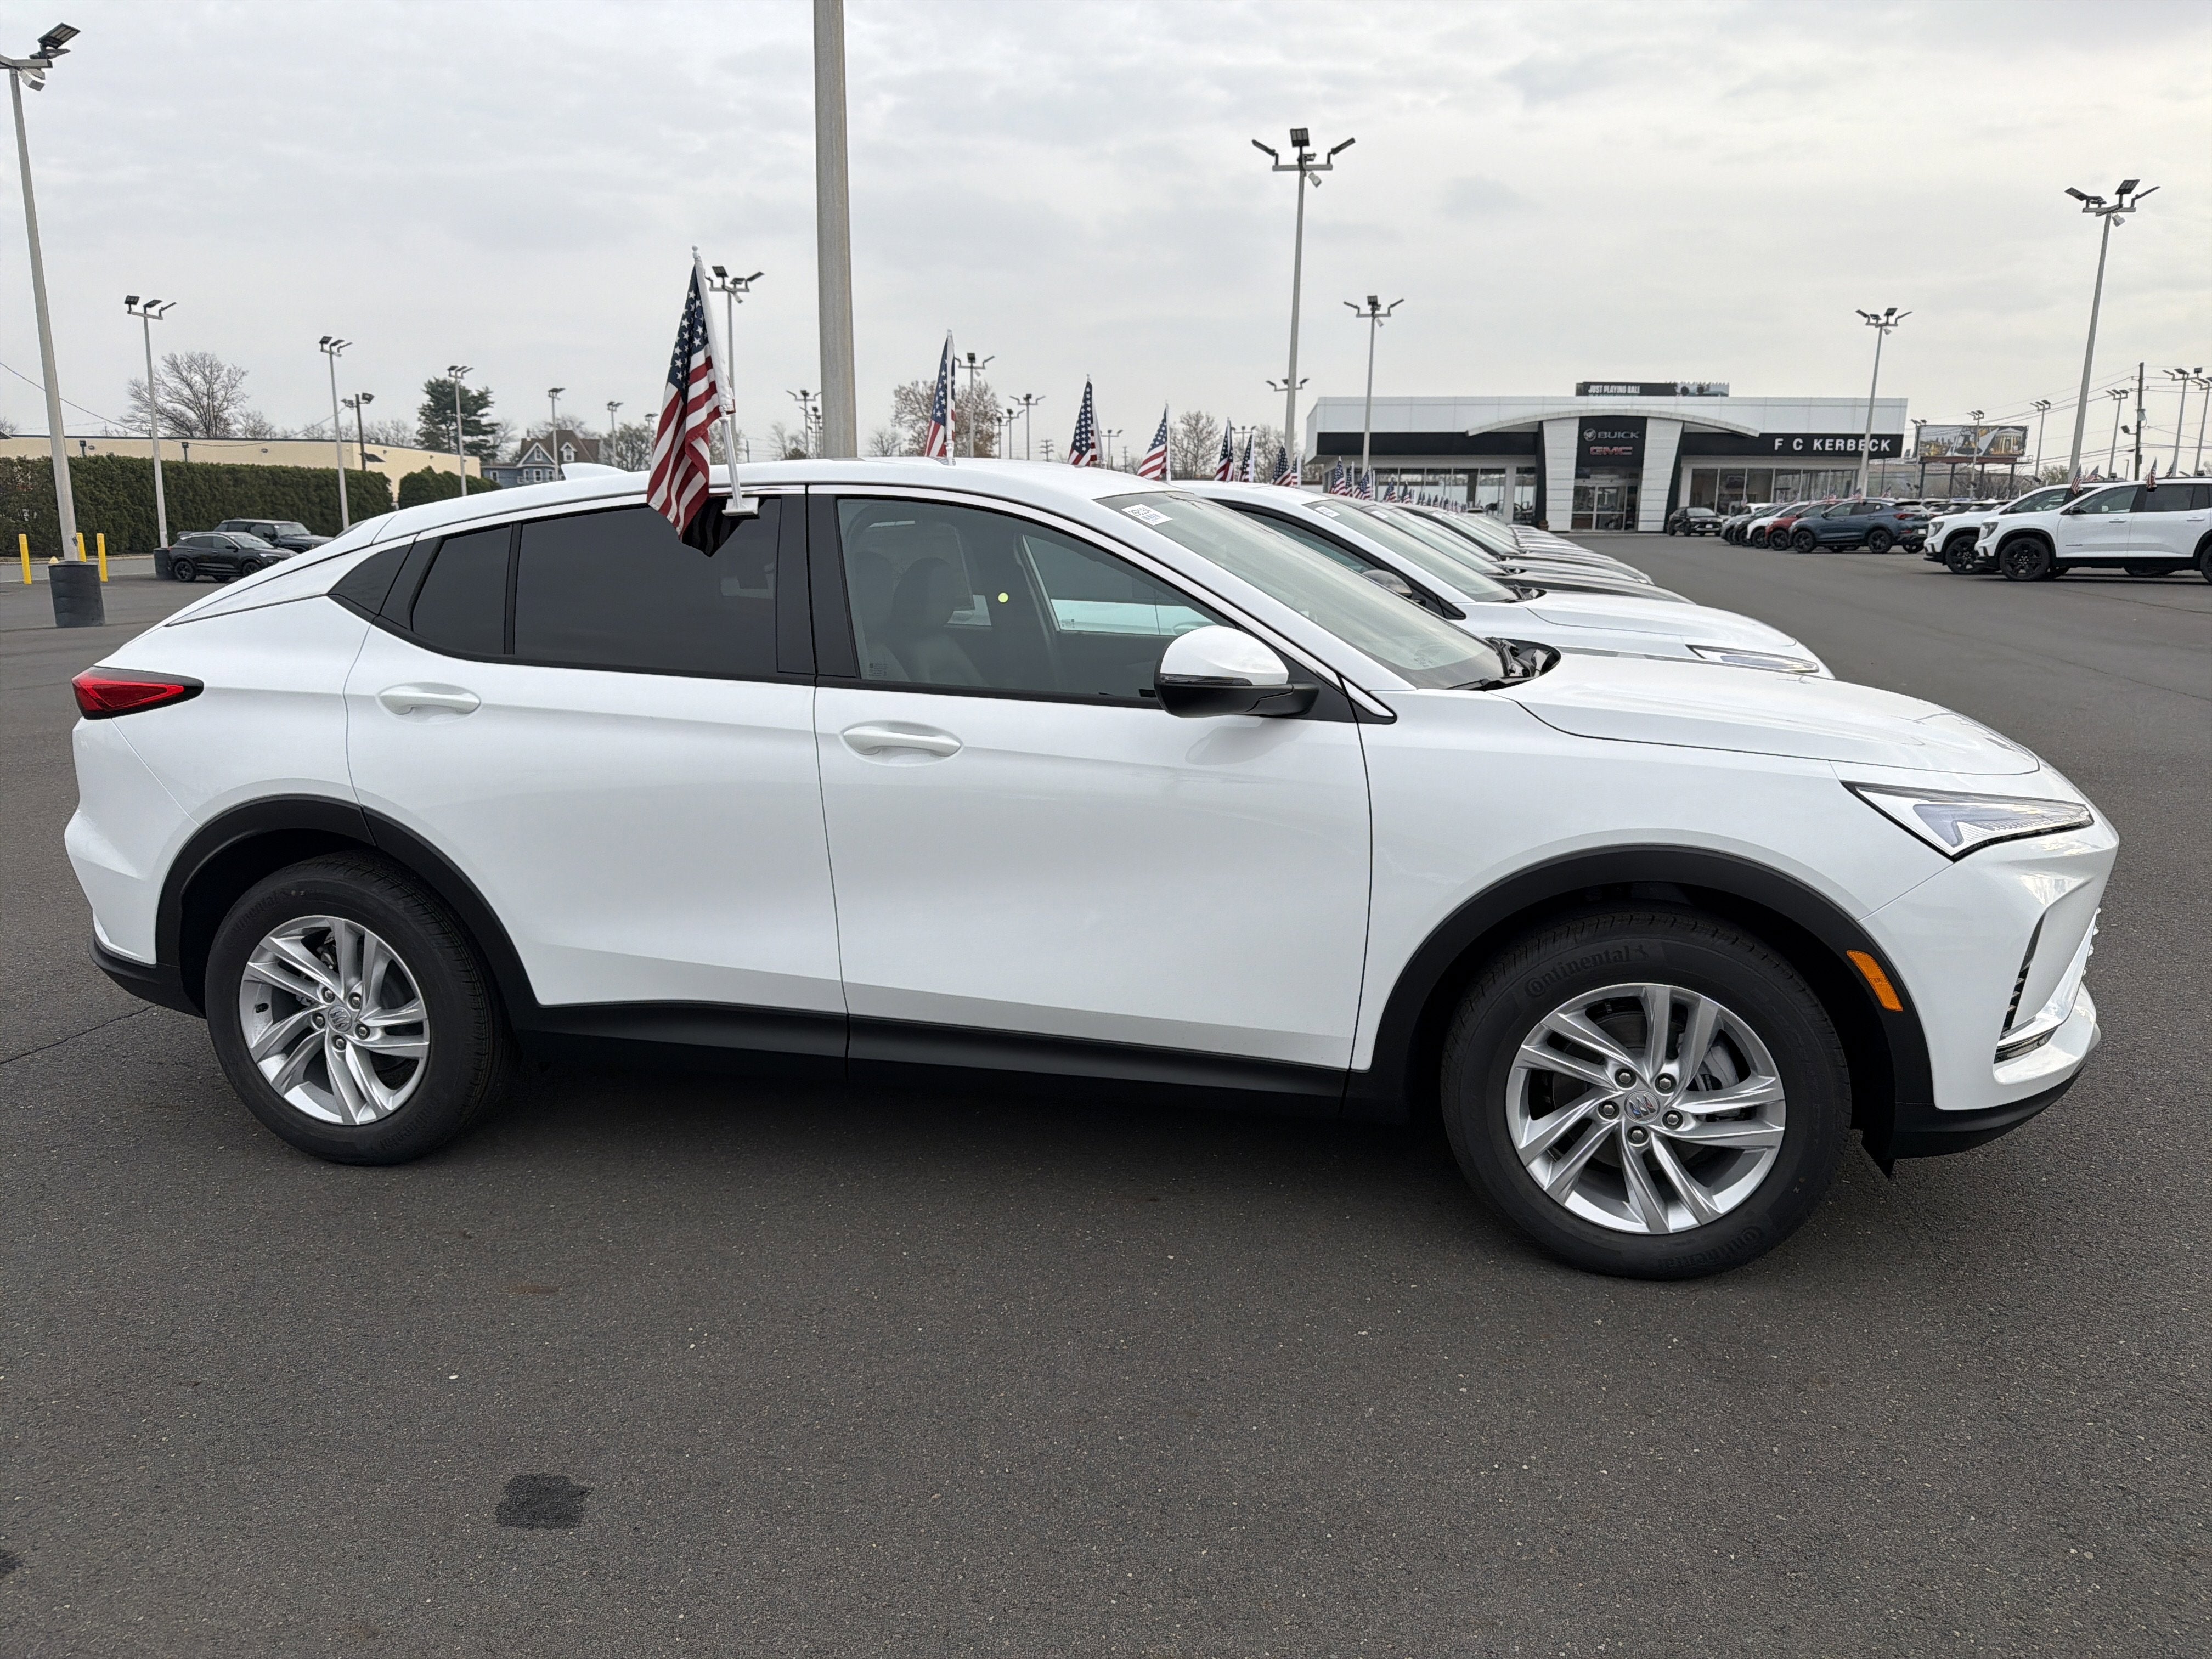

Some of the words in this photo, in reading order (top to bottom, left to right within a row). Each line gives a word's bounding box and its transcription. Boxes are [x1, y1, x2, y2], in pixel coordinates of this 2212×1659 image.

[1588, 385, 1603, 394] JUST
[1597, 431, 1640, 439] BUICK
[1774, 438, 1784, 450] F
[1792, 438, 1804, 451] C
[1813, 438, 1891, 452] KERBECK
[1589, 446, 1633, 455] GMC
[1525, 946, 1631, 997] Continental
